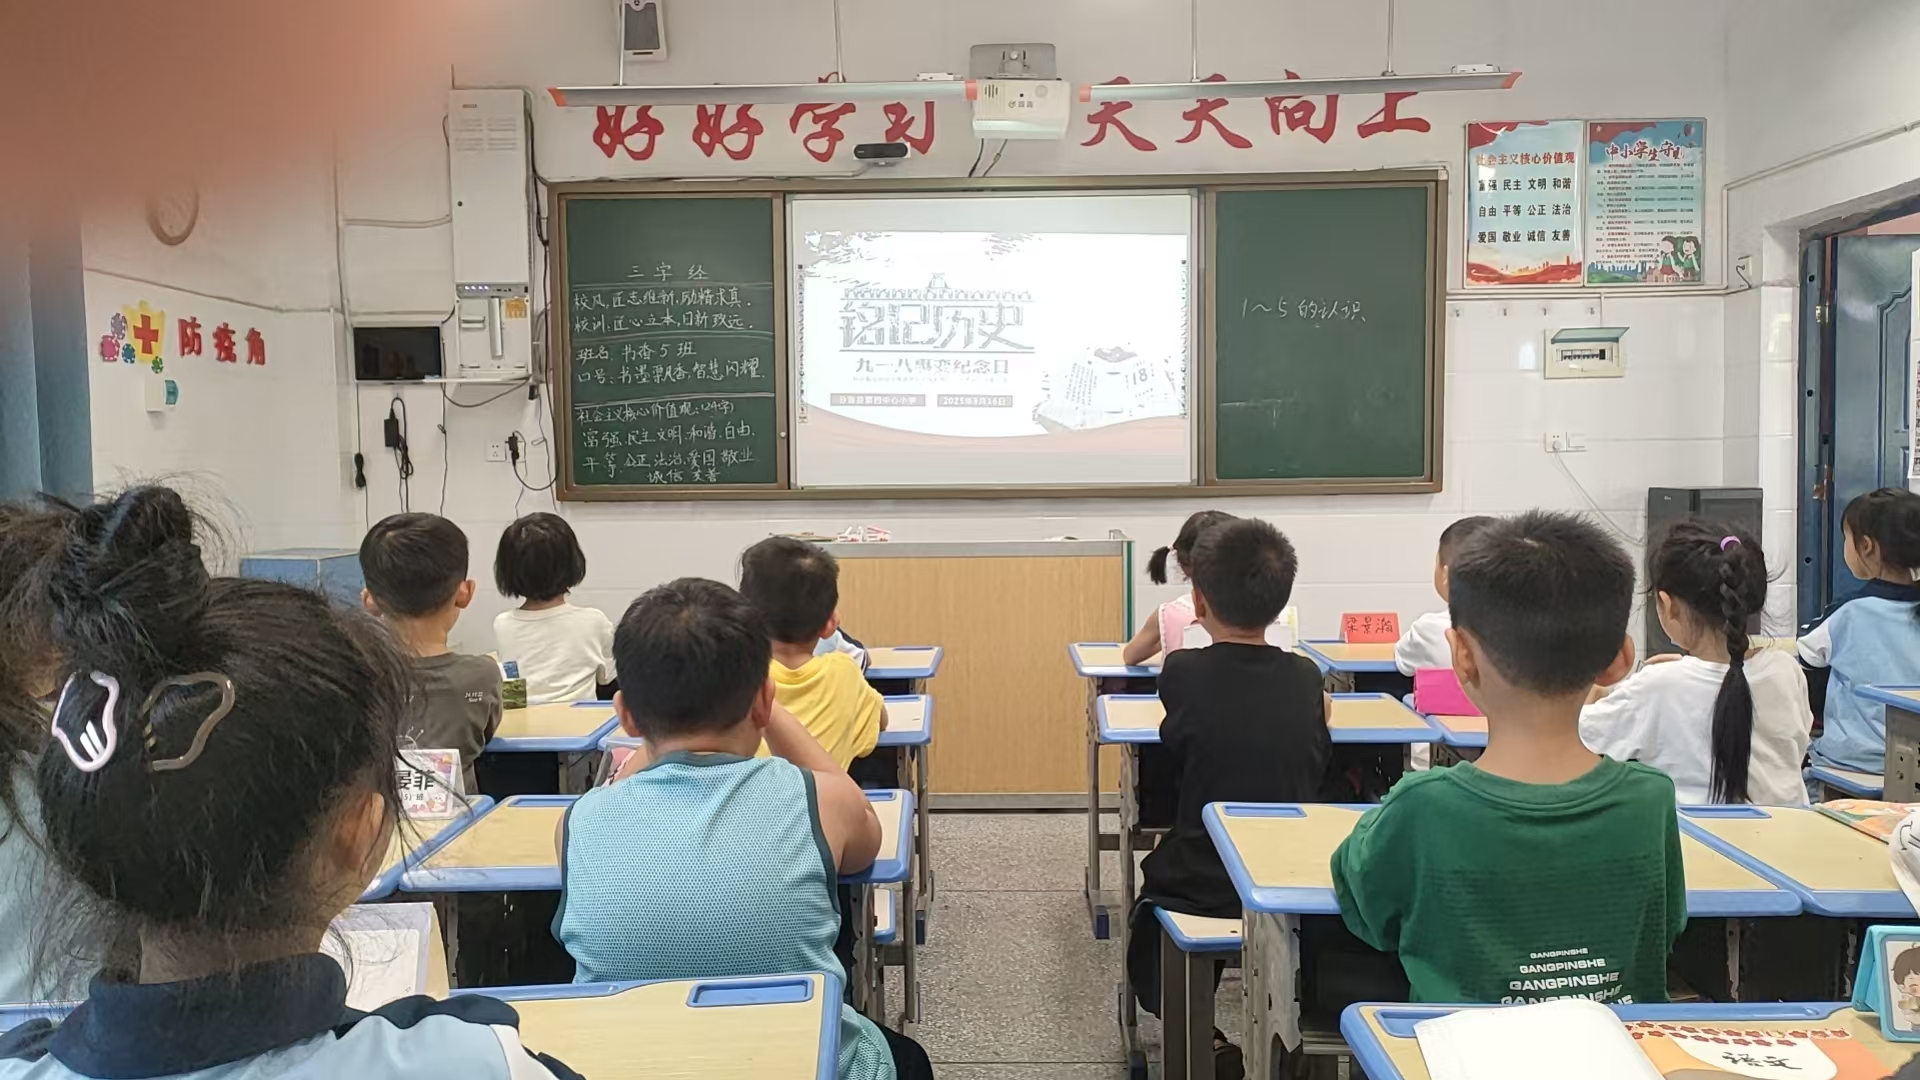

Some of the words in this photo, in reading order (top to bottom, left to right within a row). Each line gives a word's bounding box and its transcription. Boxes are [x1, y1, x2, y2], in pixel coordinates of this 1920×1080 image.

[593, 72, 935, 162] 好好学习
[1080, 69, 1431, 151] 天天向上
[1475, 151, 1575, 166] 社会主义核心价值观
[1478, 178, 1498, 192] 富强
[1503, 178, 1522, 191] 民主
[1527, 177, 1547, 190] 文明
[1552, 177, 1571, 190] 和谐
[1478, 205, 1497, 217] 自由
[1502, 204, 1522, 217] 平等
[1527, 204, 1547, 216] 公正
[1552, 203, 1571, 216] 法治
[1477, 231, 1497, 243] 爱国
[1502, 230, 1521, 243] 敬业
[1527, 230, 1546, 242] 诚信
[1551, 229, 1571, 242] 友善
[627, 261, 709, 281] 三字经
[839, 301, 1035, 349] 铭记历史
[178, 316, 266, 366] 防疫角
[1530, 948, 1588, 959] GANGPINSHE
[1519, 958, 1606, 974] GANGPINSHE
[1509, 972, 1619, 991] GANGPINSHE
[1721, 1051, 1803, 1070] 语文
